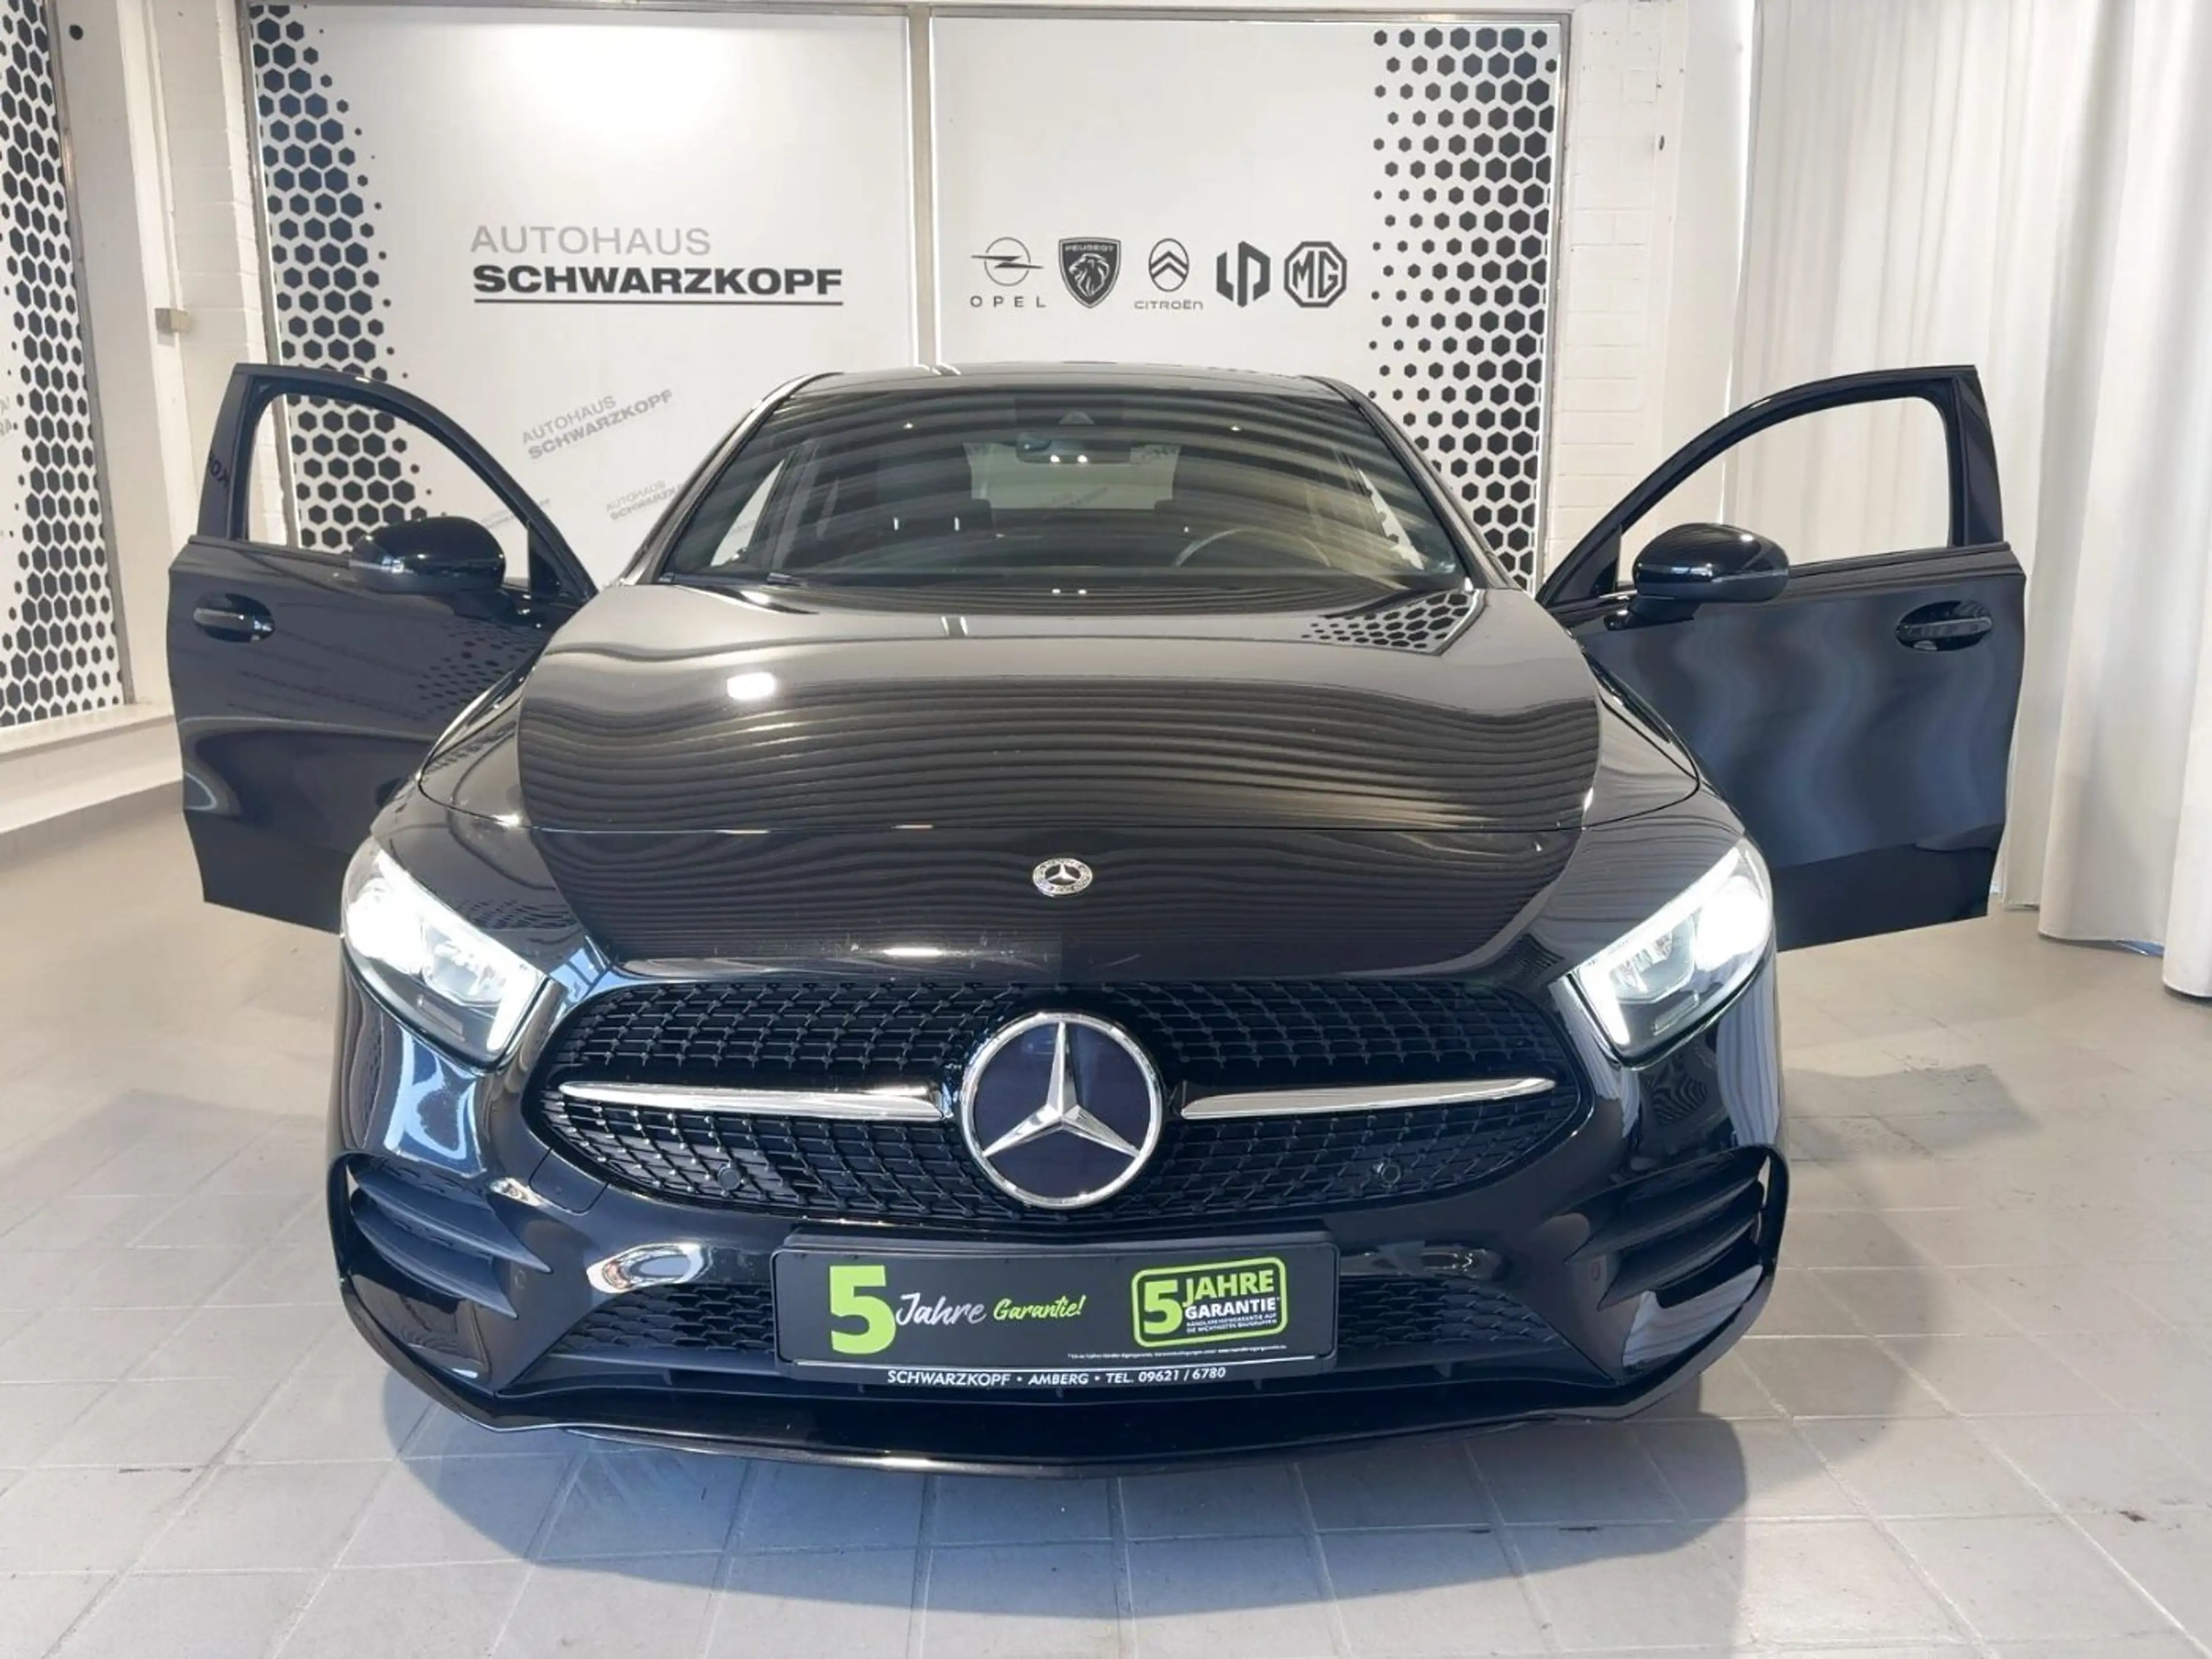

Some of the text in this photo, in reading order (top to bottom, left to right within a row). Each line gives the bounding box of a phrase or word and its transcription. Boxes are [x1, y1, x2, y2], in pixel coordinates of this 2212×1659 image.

[469, 225, 711, 255] AUTOHAUS
[474, 265, 842, 295] SCHWARZKOPF
[1291, 250, 1338, 299] MG
[970, 296, 1046, 308] OPEL
[1134, 300, 1204, 310] CITROËN
[522, 395, 616, 444] AUTOHAUS
[528, 389, 673, 460] SCHWARZKOPF
[830, 1265, 1087, 1354] 5 Jahre Garantie!
[1143, 1269, 1274, 1335] 5 JAHRE
[887, 1369, 1011, 1386] SCHWARZKOPF
[1028, 1373, 1089, 1385] AMBERG
[1105, 1372, 1134, 1384] TEL.
[1138, 1369, 1180, 1382] 09621
[1192, 1366, 1226, 1380] 6780
